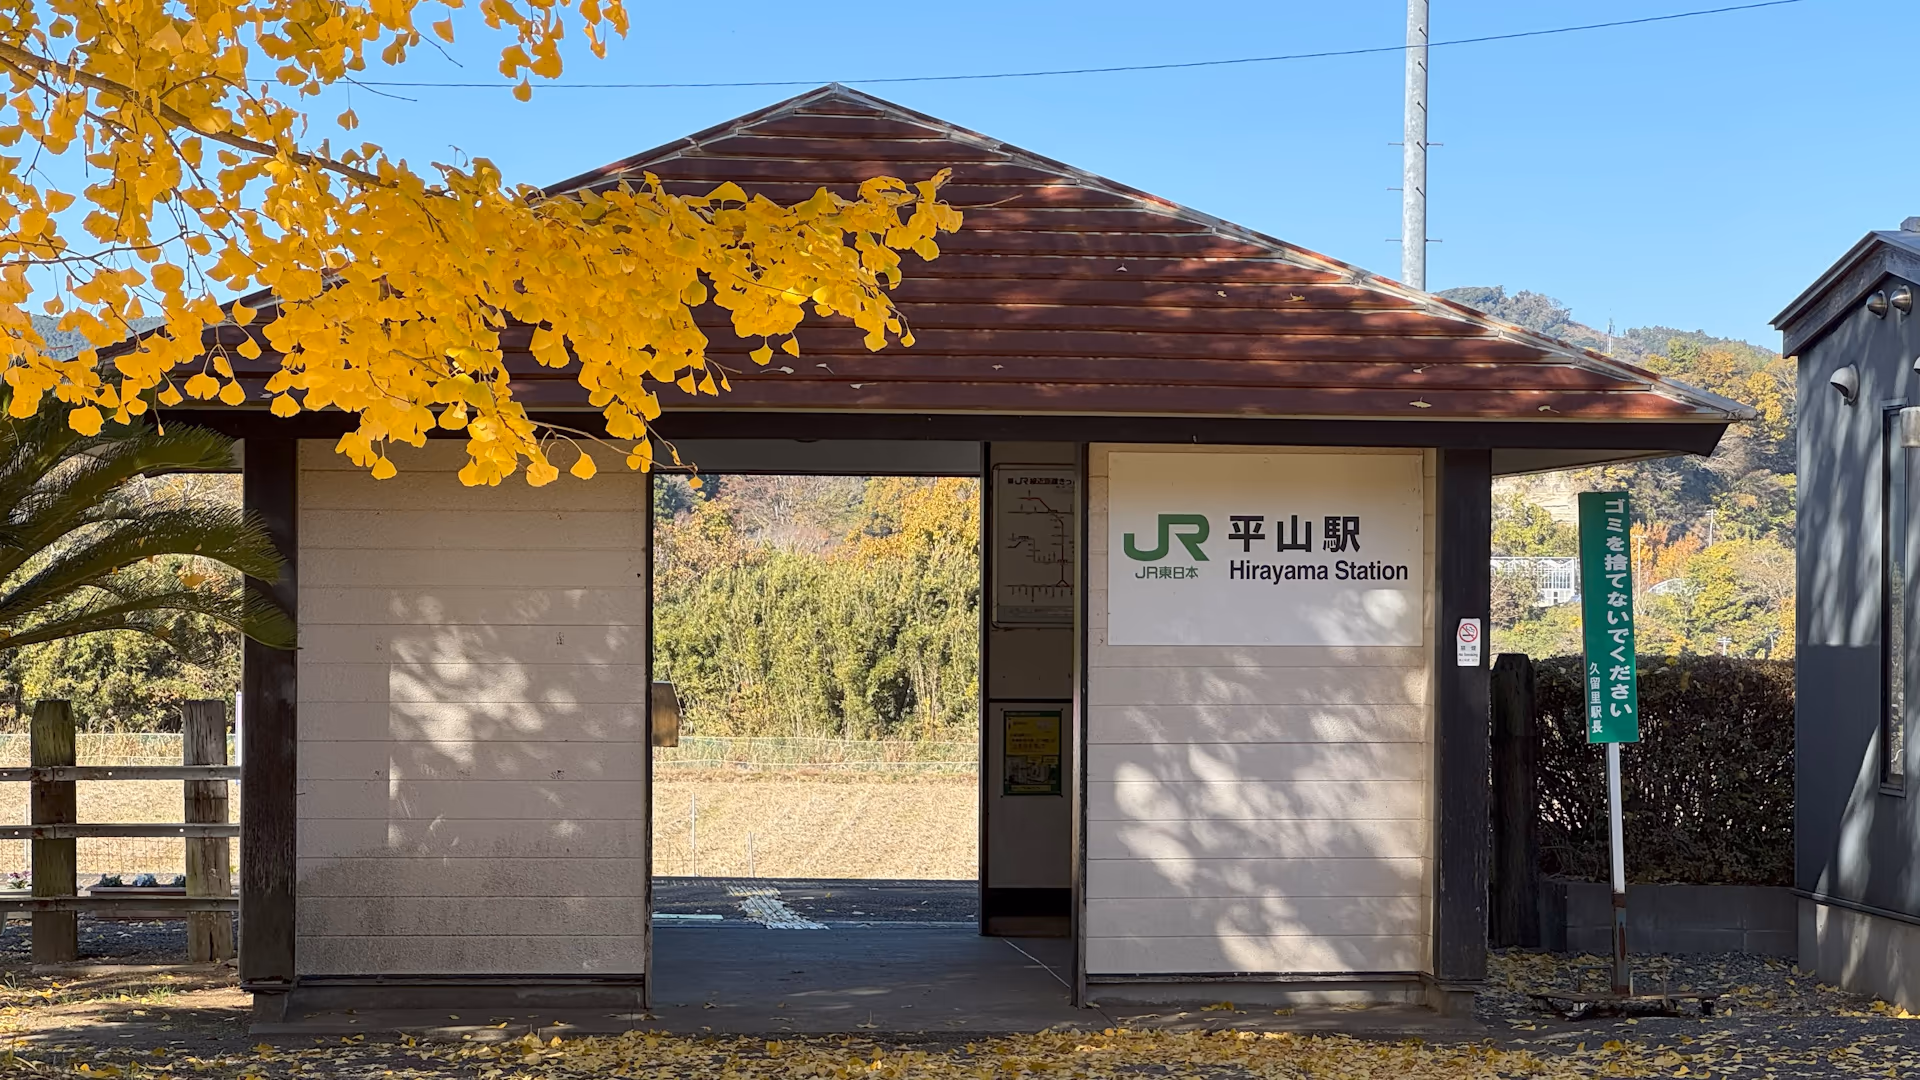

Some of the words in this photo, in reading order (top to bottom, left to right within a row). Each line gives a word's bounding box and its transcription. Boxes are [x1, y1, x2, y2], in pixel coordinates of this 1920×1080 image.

[1124, 514, 1210, 561] JR
[1228, 515, 1360, 552] 平山駅
[1135, 566, 1199, 579] JR東日本
[1230, 560, 1328, 585] Hirayama
[1335, 560, 1408, 580] Station
[1605, 498, 1632, 717] ゴミを捨てないでください
[1590, 662, 1603, 733] 久留里駅長
